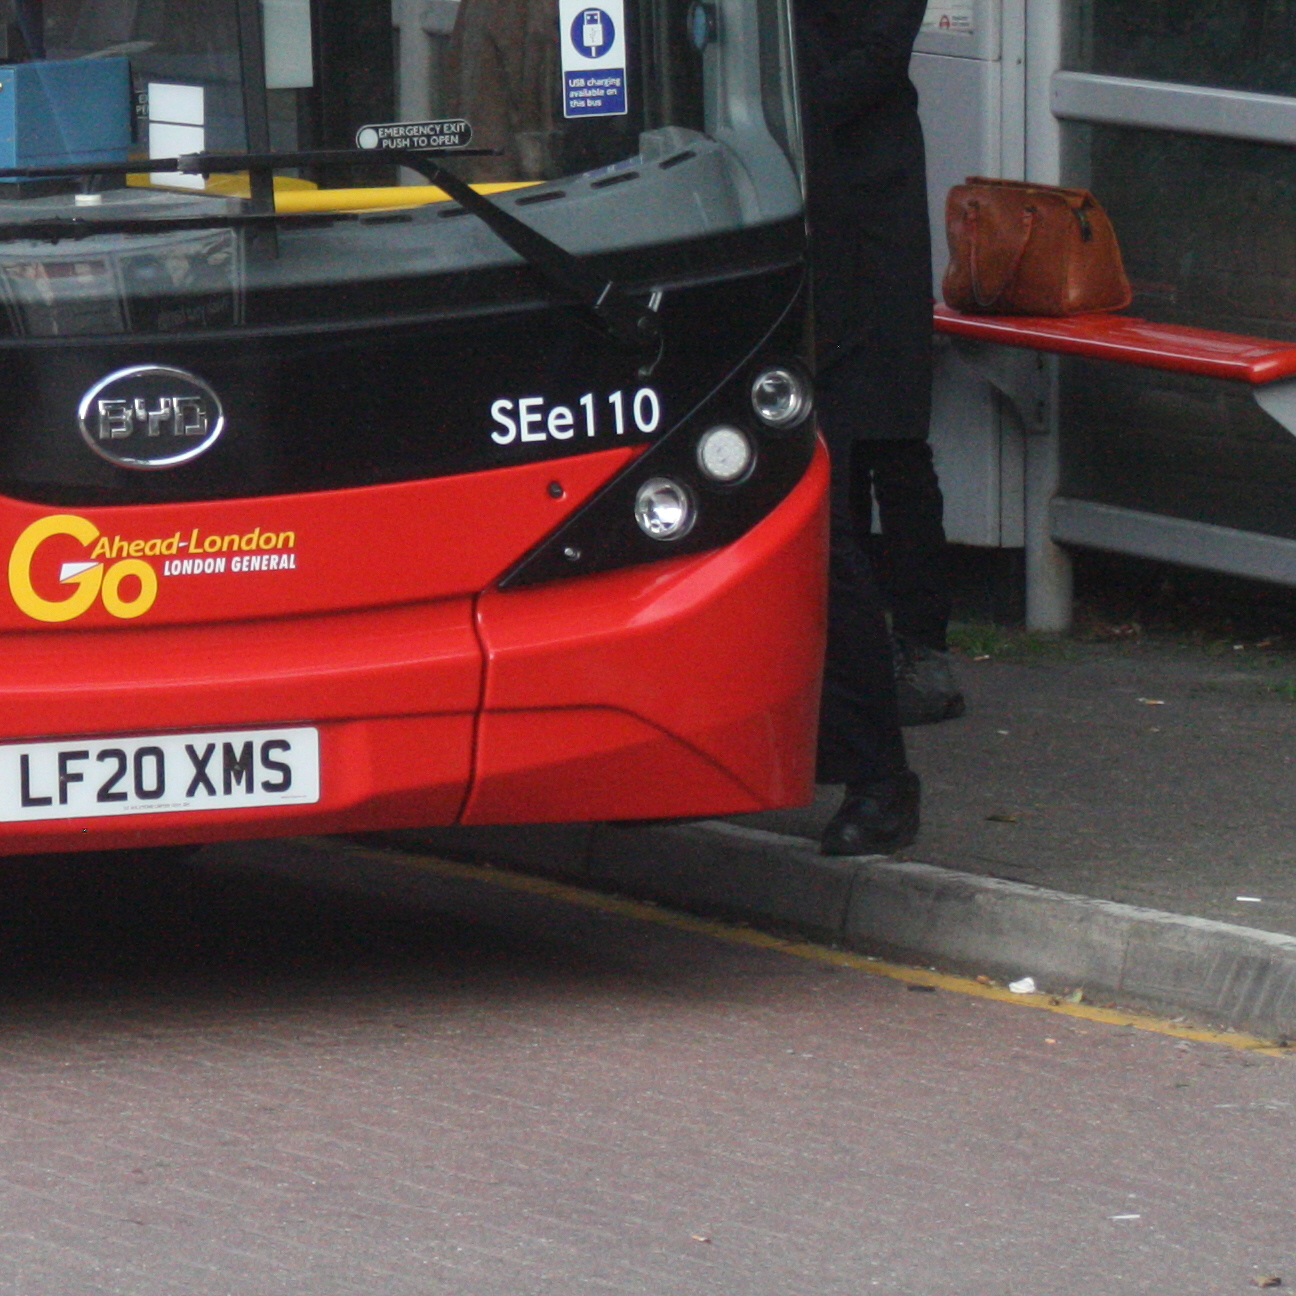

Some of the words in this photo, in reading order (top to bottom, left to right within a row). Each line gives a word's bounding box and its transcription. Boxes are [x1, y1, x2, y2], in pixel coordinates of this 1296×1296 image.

[569, 78, 585, 88] USB
[587, 77, 621, 88] charging
[569, 88, 605, 98] available
[587, 99, 602, 107] bus
[378, 124, 441, 138] EMERGENCY
[443, 122, 466, 133] EXIT
[382, 138, 410, 149] PUSH
[412, 137, 427, 147] TO
[430, 134, 459, 146] OPEN
[98, 396, 207, 439] BYD
[491, 388, 660, 445] SEe110
[9, 515, 157, 622] Go
[91, 526, 296, 559] Ahead-London
[163, 558, 226, 577] LONDON
[230, 553, 296, 574] GENERAL
[20, 747, 165, 807] LF20
[185, 739, 291, 799] XMS
